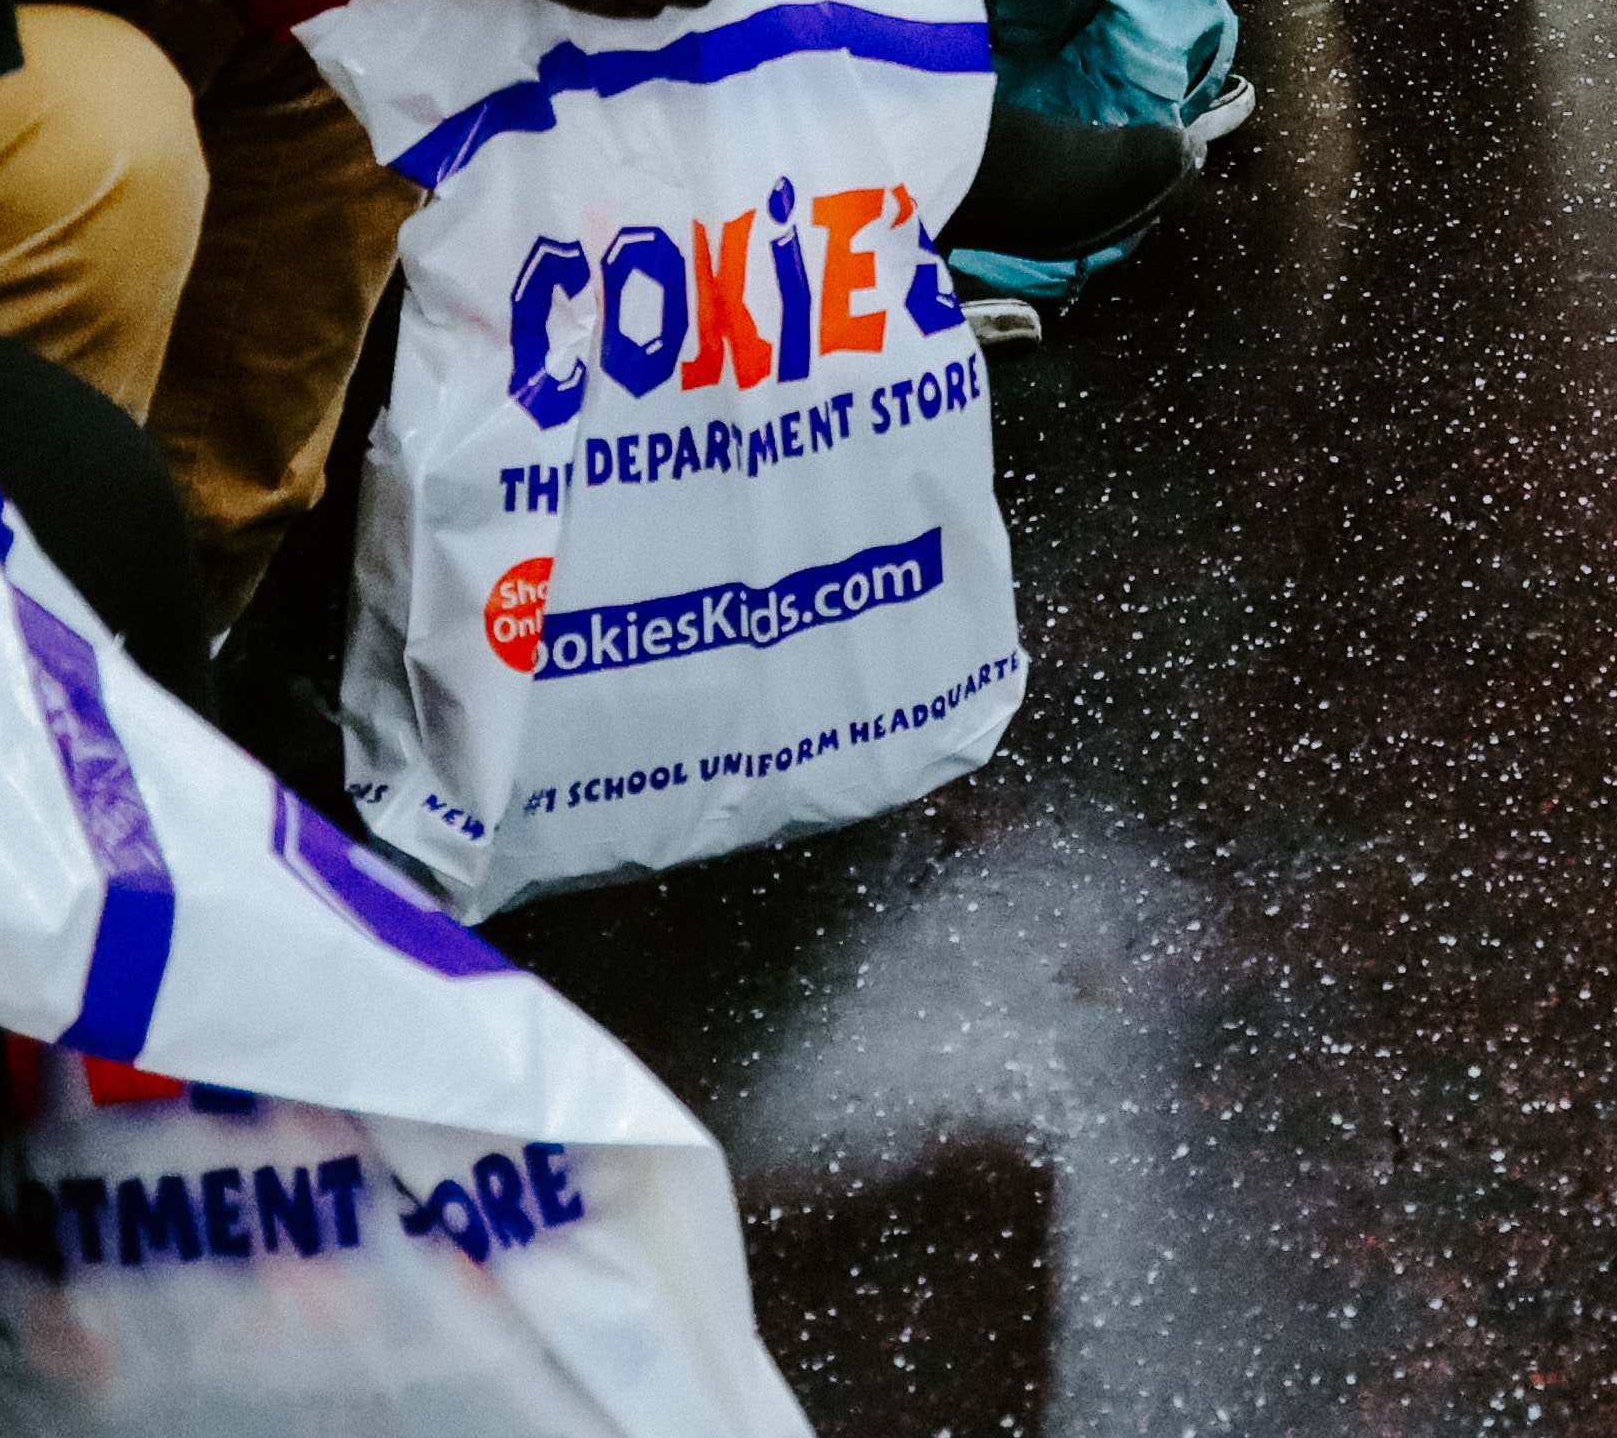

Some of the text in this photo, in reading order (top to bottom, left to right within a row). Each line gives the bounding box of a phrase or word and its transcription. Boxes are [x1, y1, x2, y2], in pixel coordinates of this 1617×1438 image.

[871, 353, 981, 435] STORE
[492, 612, 544, 643] Onl
[500, 581, 548, 611] Sho
[531, 558, 922, 675] ookiesKids.com
[568, 762, 688, 809] SCHOOL
[699, 728, 839, 782] UNIFORM
[849, 650, 1020, 745] HEADQUARTE
